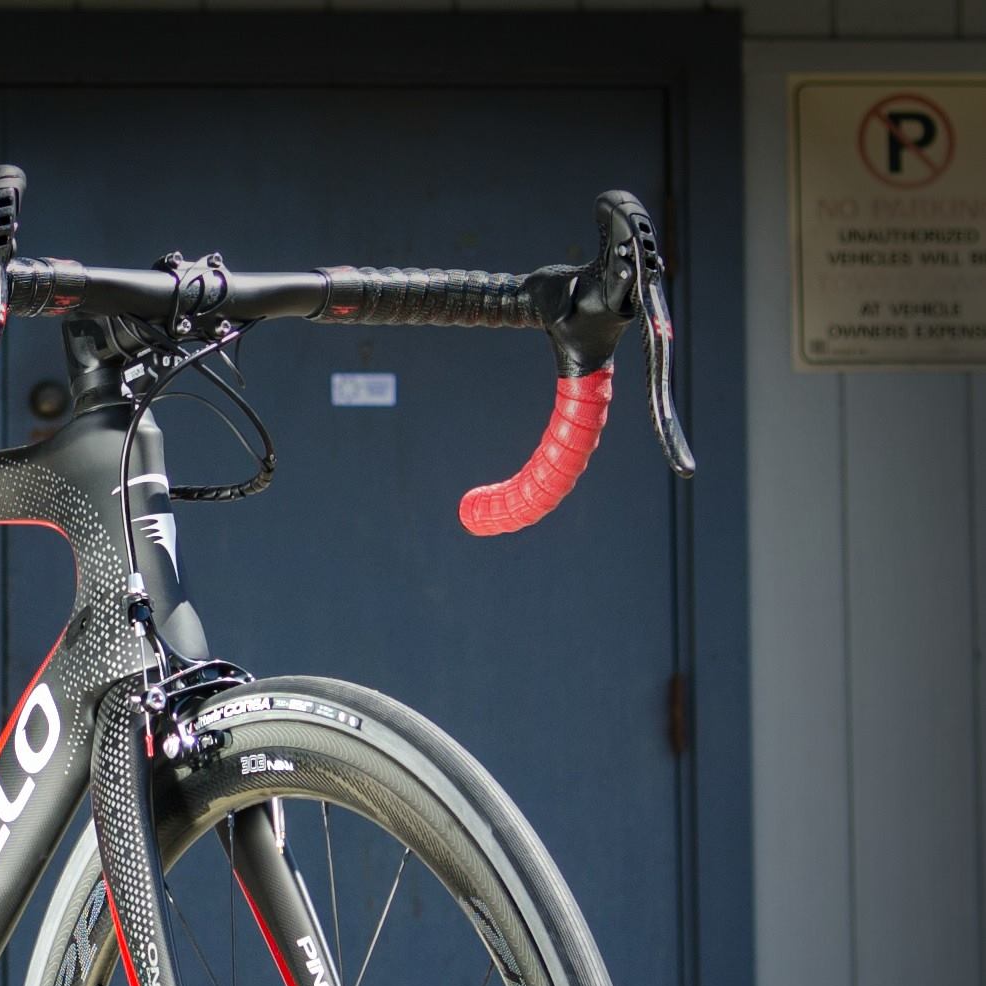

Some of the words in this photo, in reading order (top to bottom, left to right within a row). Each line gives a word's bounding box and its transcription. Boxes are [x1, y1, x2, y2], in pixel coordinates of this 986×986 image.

[887, 112, 937, 174] P
[838, 227, 981, 244] UNAUTHORIZED
[827, 250, 913, 267] VEHICLES
[920, 250, 961, 267] WILL
[859, 301, 880, 316] AT
[890, 301, 962, 317] VEHICLE
[828, 323, 909, 339] OWNERS
[240, 753, 267, 775] 303
